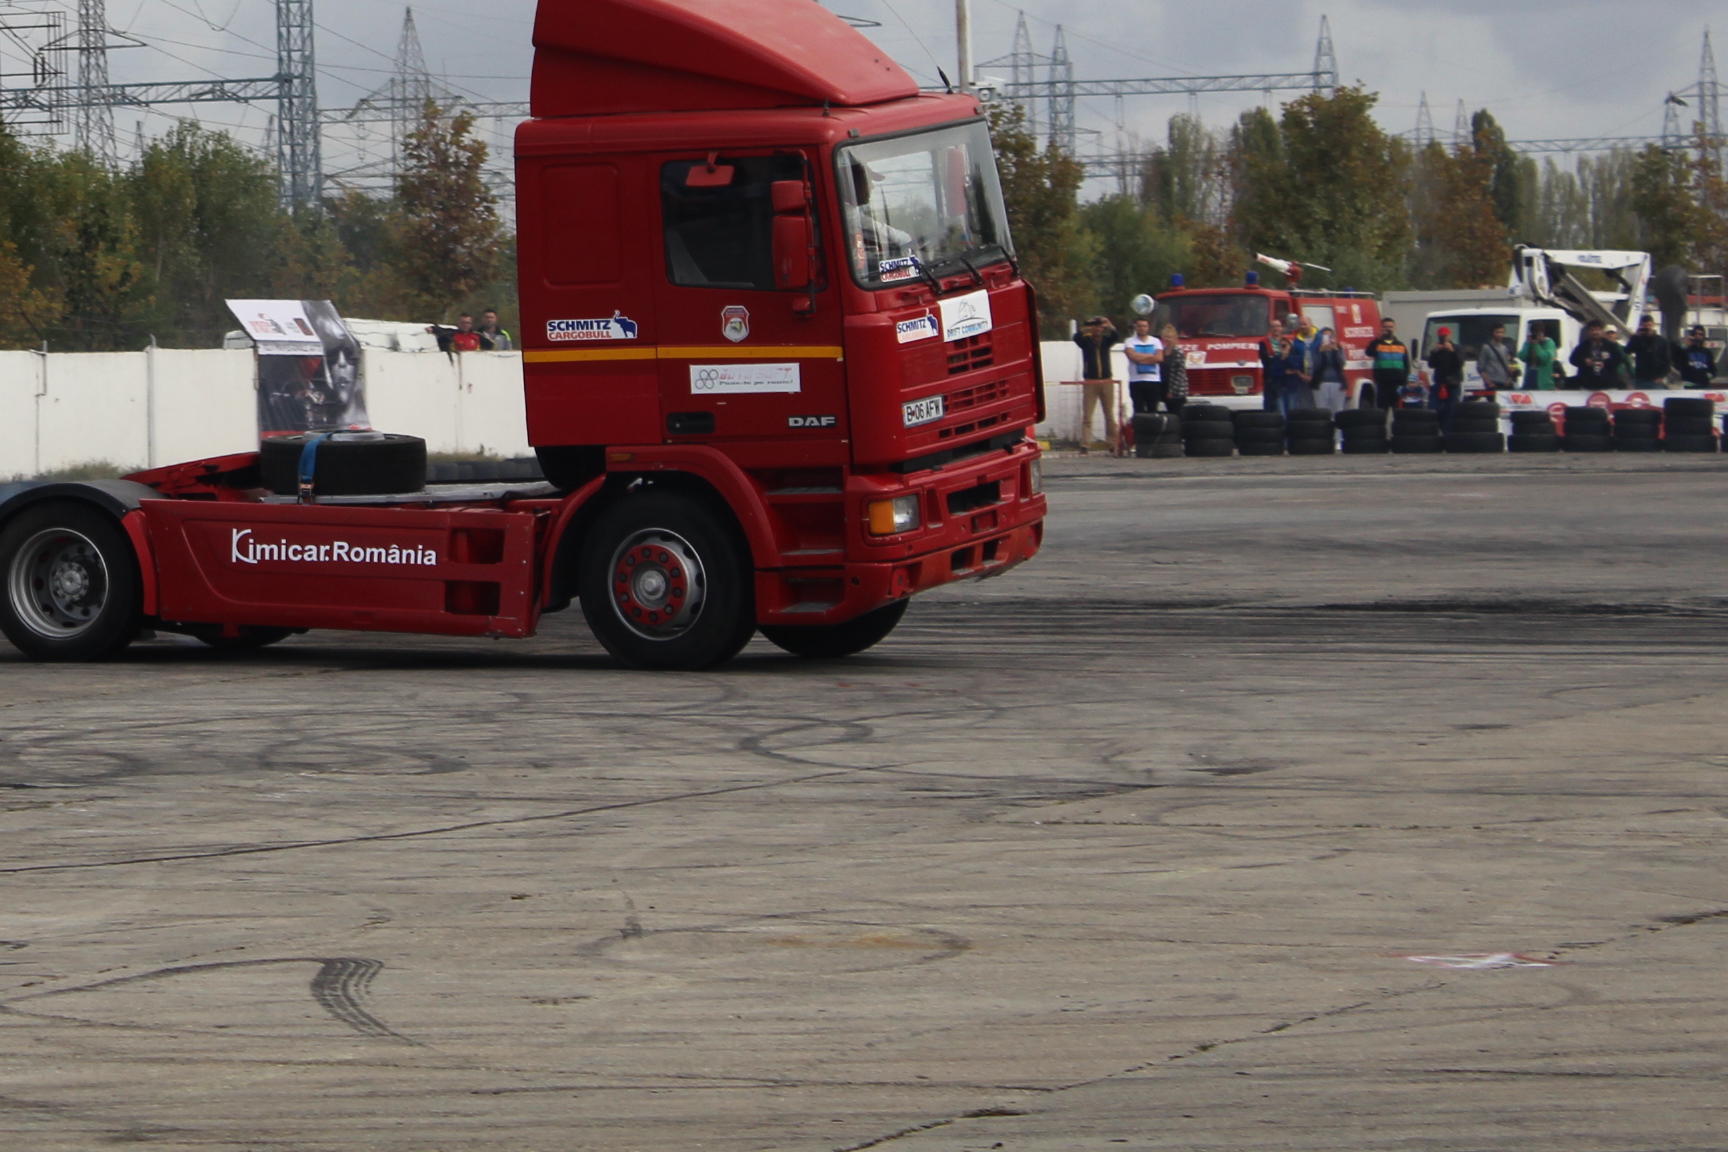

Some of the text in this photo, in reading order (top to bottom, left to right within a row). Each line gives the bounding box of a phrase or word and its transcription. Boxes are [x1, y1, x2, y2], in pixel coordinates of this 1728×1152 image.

[879, 258, 909, 272] SCHMITZ
[547, 320, 611, 331] SCHMITZ
[897, 318, 927, 334] SCHMITZ
[947, 321, 988, 338] DRIFT COMMUNITY
[548, 331, 612, 340] CARGOBULL
[788, 416, 835, 427] DAF
